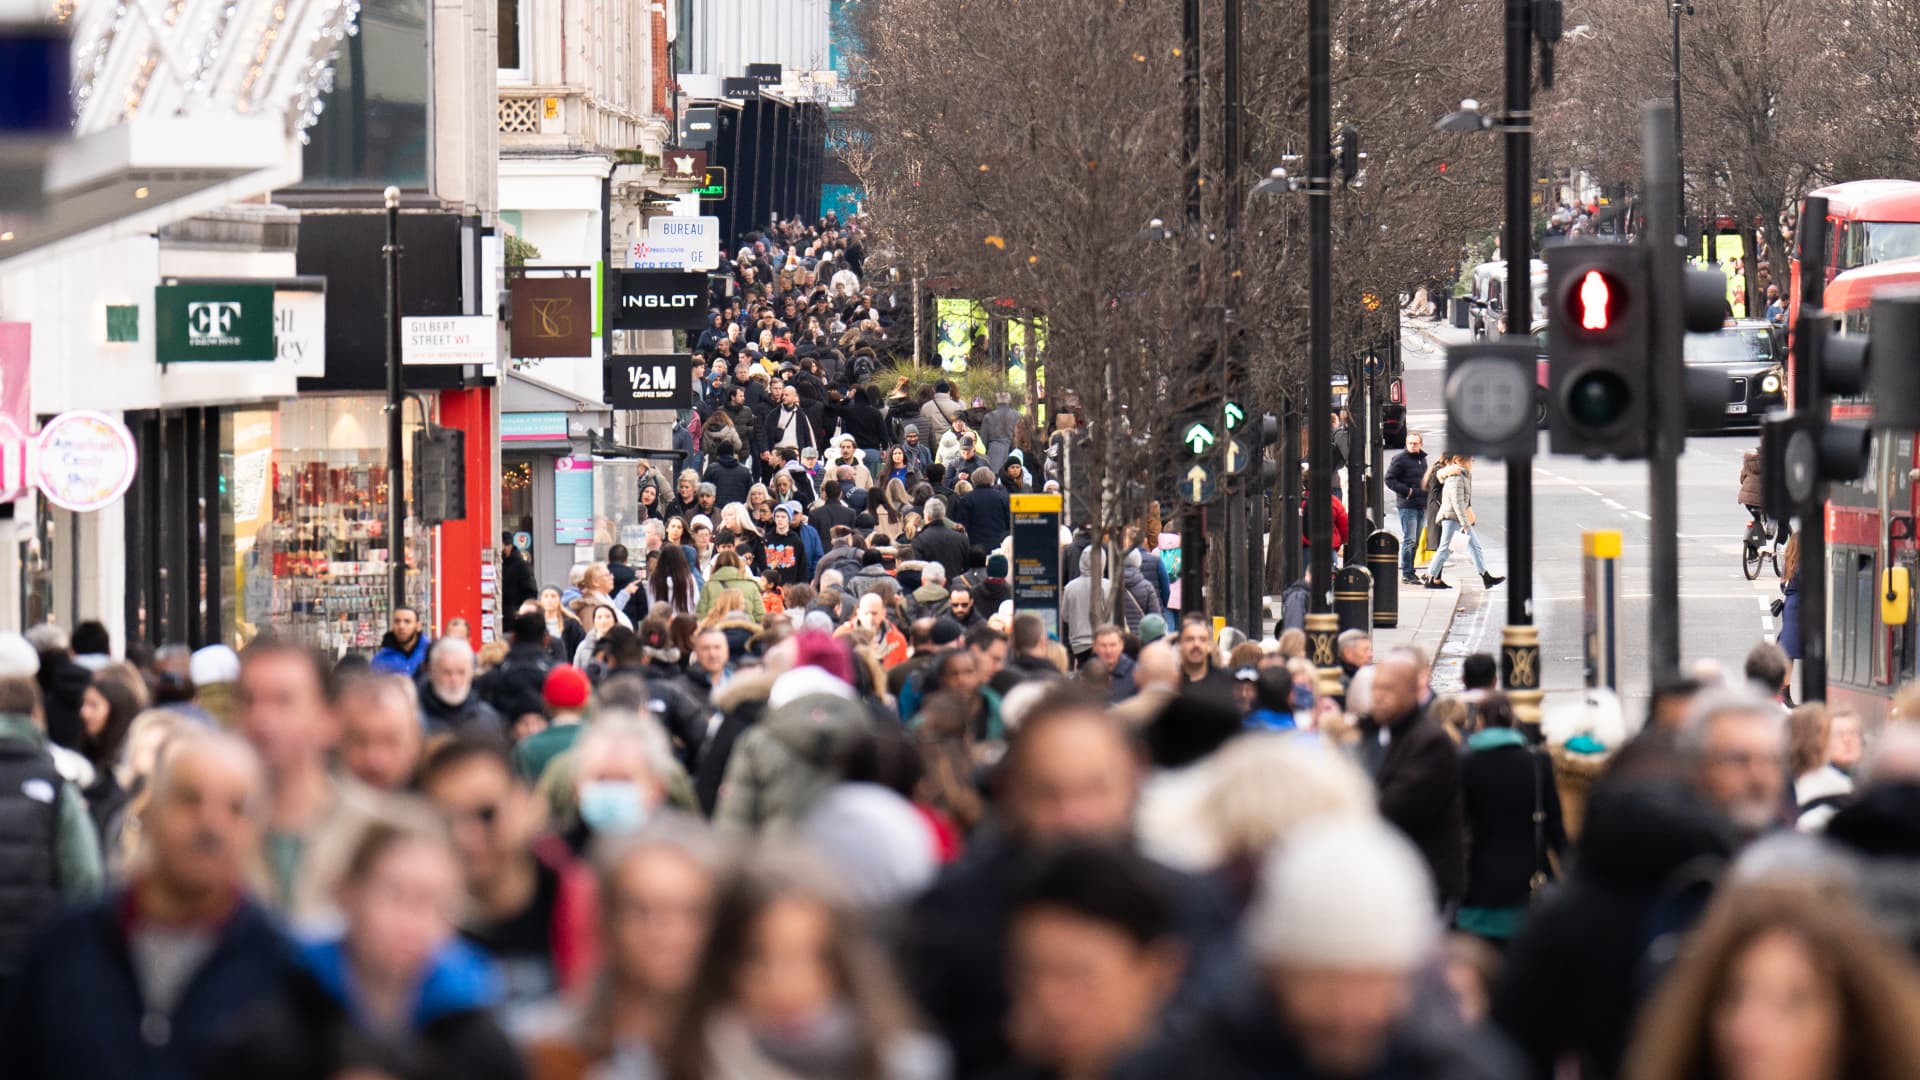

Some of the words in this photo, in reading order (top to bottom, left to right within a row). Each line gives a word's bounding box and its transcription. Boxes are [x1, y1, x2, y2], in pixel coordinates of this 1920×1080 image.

[728, 89, 757, 97] ZARA
[691, 185, 724, 195] LEX
[663, 223, 704, 235] BUREAU
[622, 294, 699, 308] INGLOT
[411, 321, 456, 333] GILBERT
[411, 335, 451, 346] STREET
[455, 335, 470, 345] W1
[632, 391, 656, 399] COFFEE
[656, 391, 674, 399] SHOP
